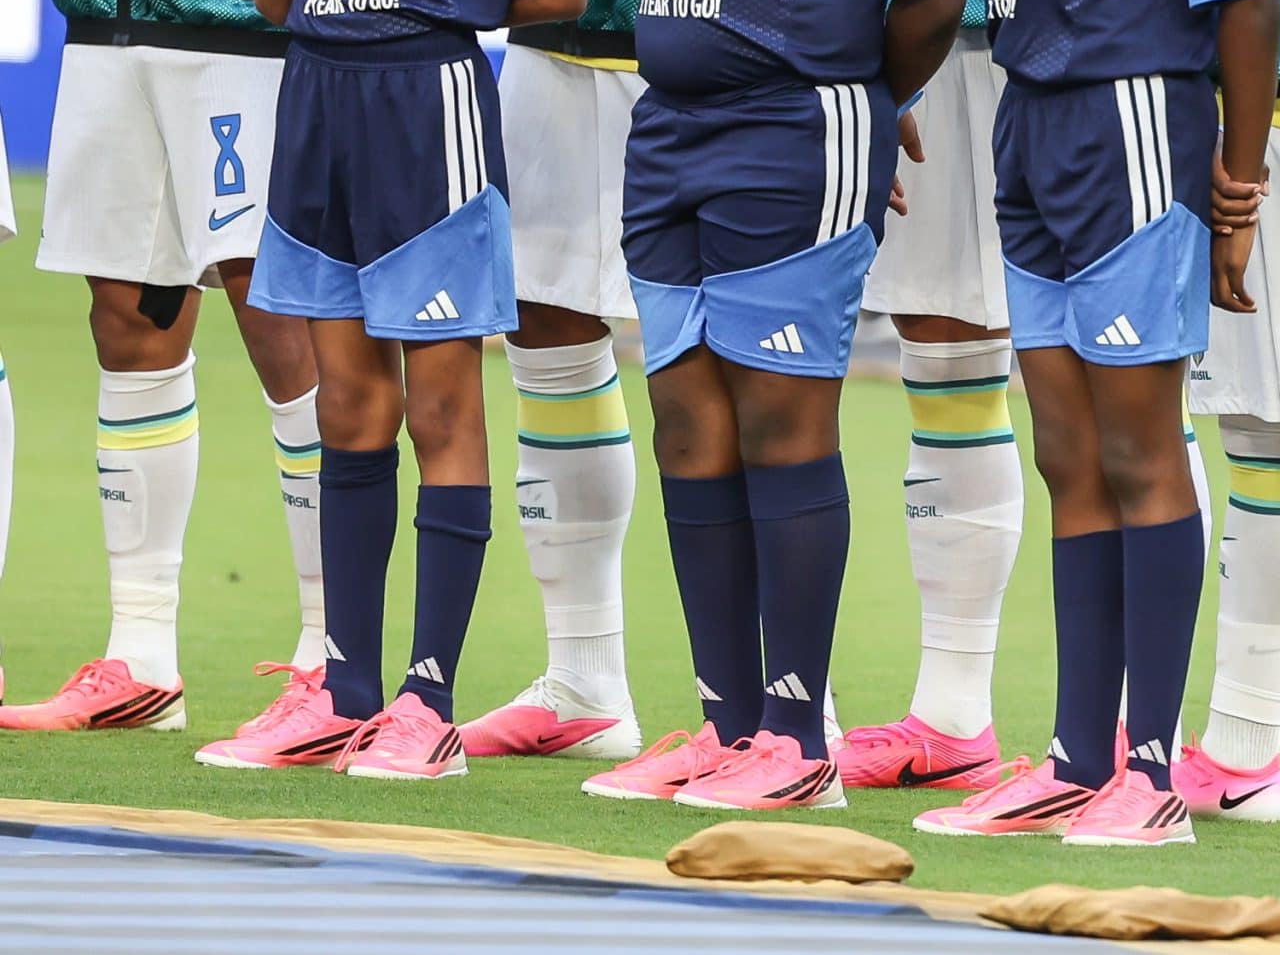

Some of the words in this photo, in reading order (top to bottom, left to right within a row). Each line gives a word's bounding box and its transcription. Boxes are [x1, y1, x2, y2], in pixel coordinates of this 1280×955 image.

[210, 113, 245, 197] 8
[518, 504, 552, 520] ASIL
[905, 503, 944, 518] RASIL
